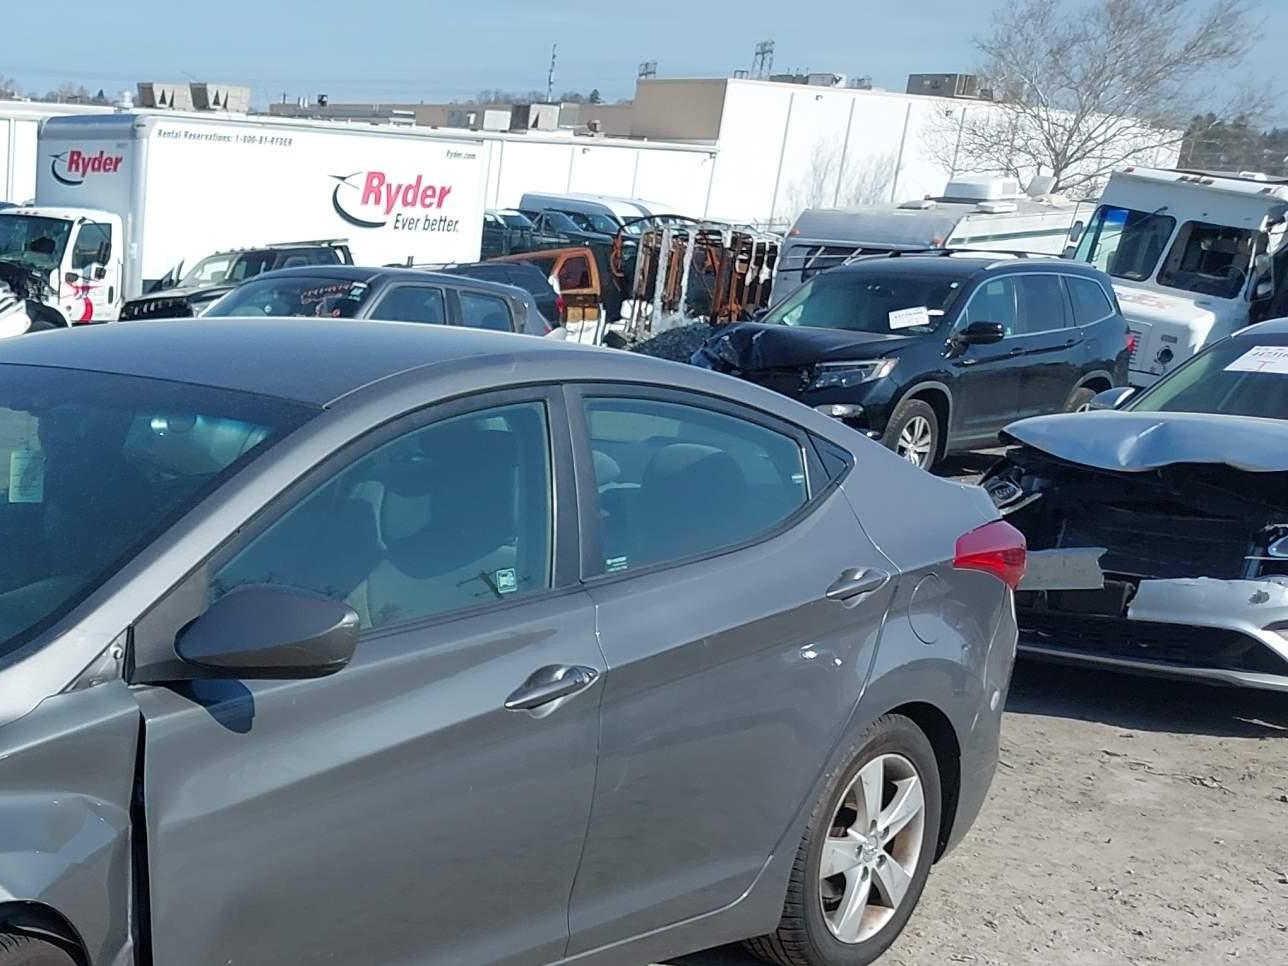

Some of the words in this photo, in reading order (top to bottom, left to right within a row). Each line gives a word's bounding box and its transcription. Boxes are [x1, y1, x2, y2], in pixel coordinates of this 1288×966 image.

[158, 129, 181, 139] Rental
[184, 130, 233, 142] Reservations:
[67, 150, 123, 178] Ryder
[446, 150, 476, 160] Ryder.com
[360, 171, 453, 215] Ryder
[393, 213, 421, 231] Ever
[423, 214, 460, 232] better.
